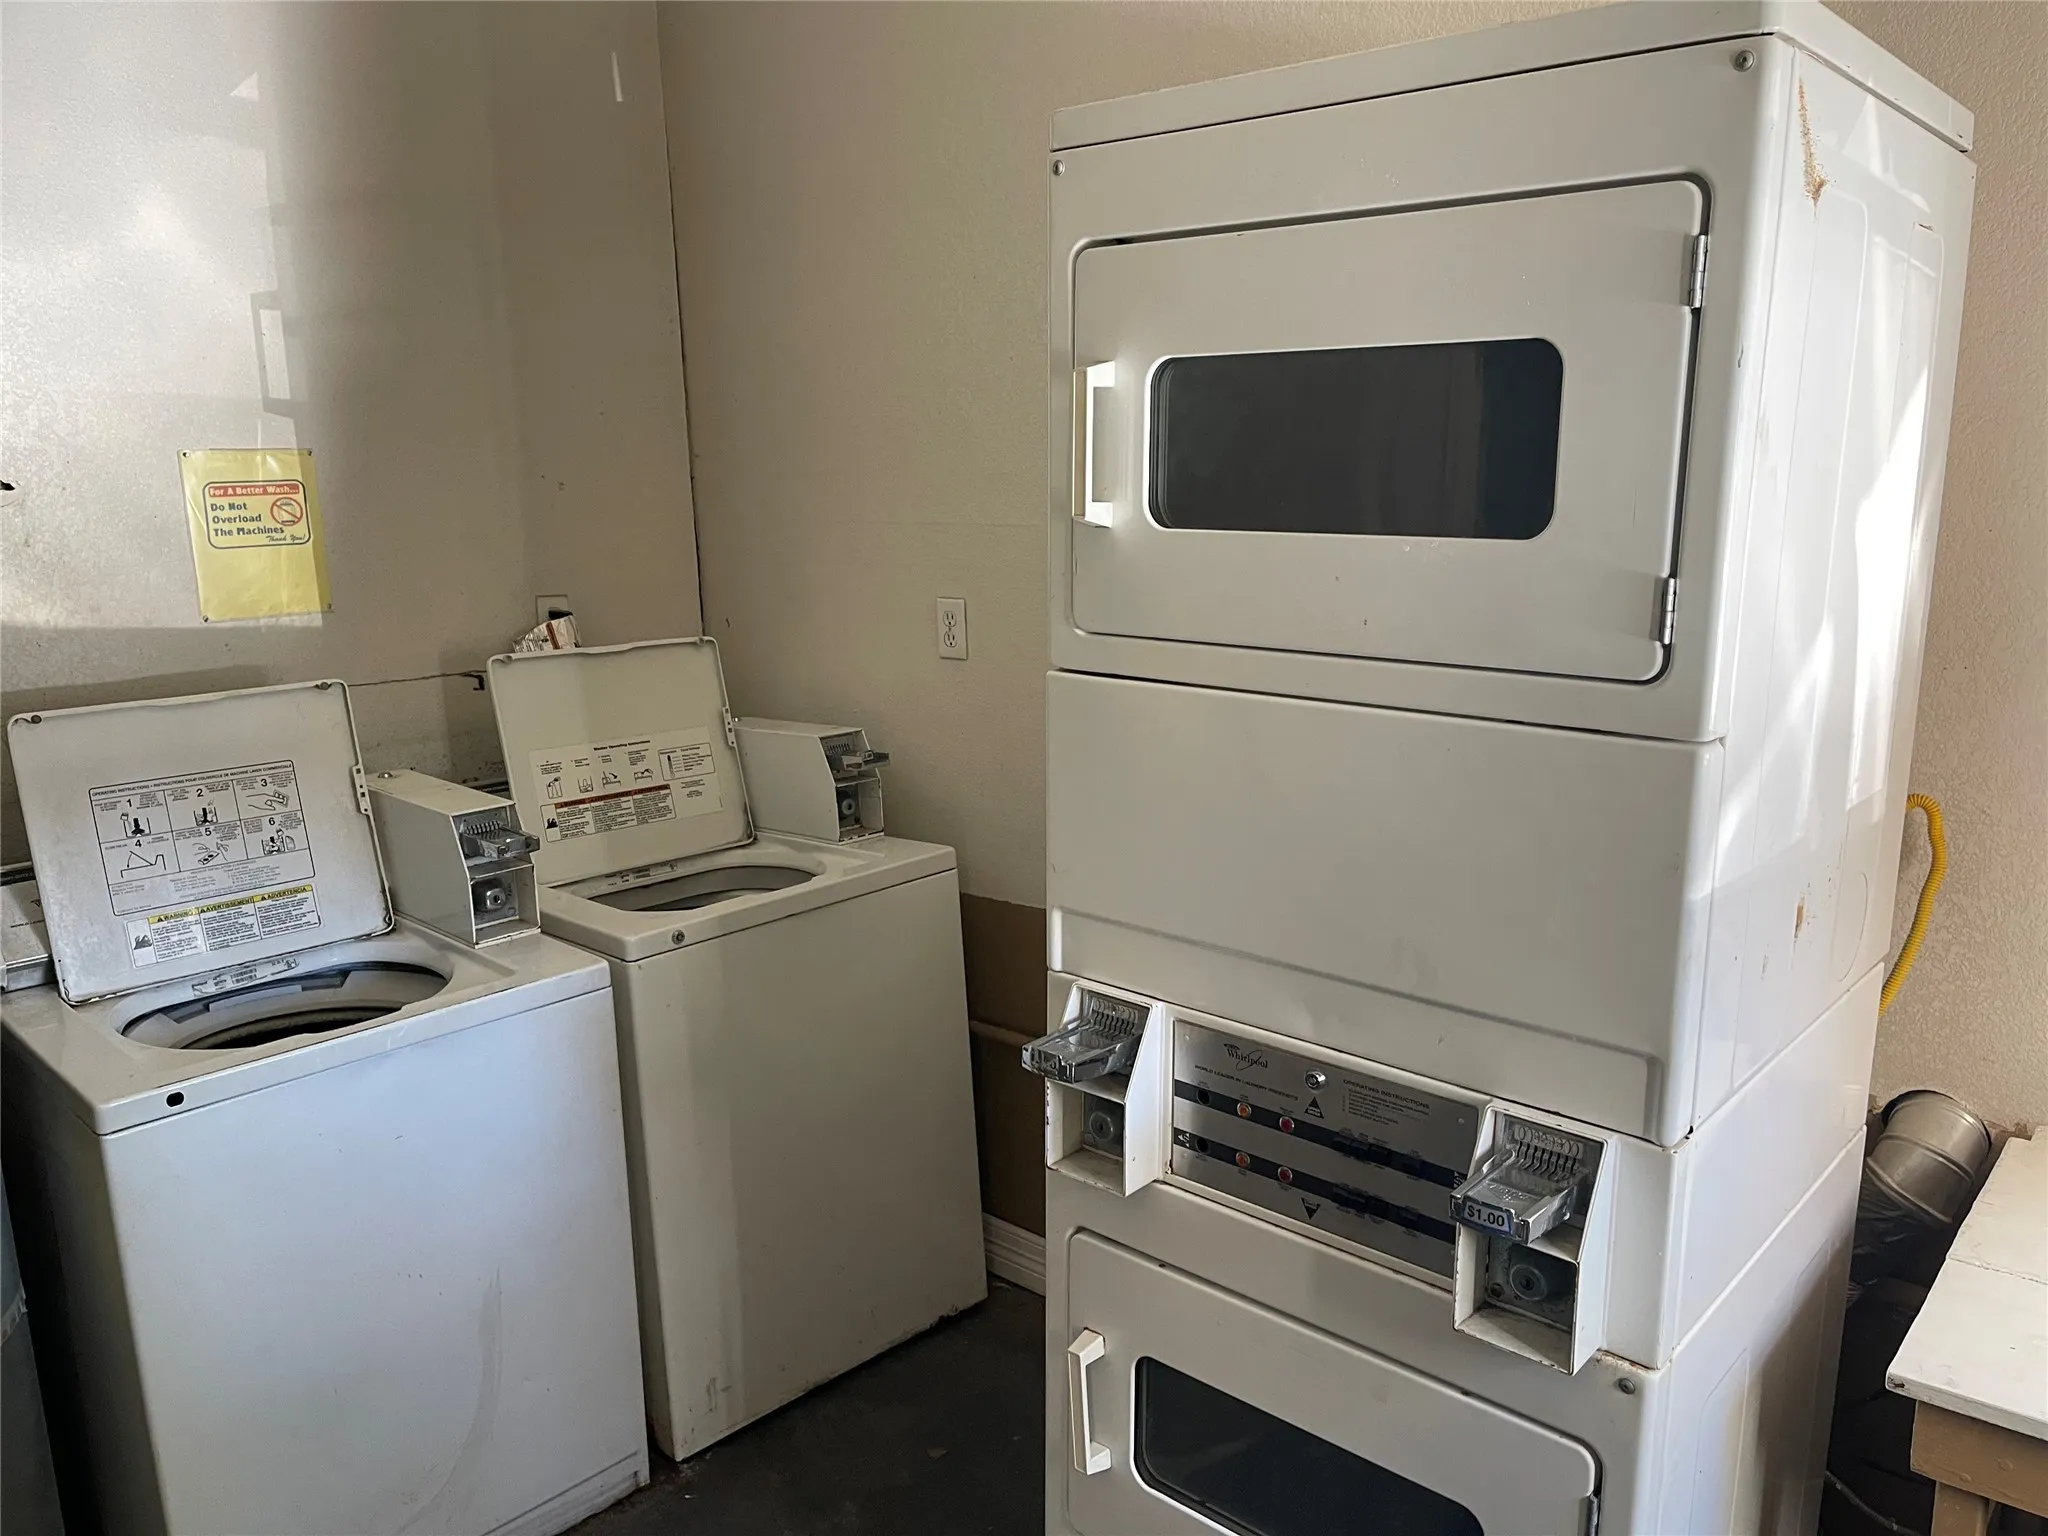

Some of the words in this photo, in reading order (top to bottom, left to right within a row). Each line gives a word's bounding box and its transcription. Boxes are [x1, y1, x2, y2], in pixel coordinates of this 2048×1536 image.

[209, 487, 224, 496] For
[227, 487, 234, 495] A
[235, 486, 264, 495] Better
[265, 485, 299, 494] Wash...
[210, 503, 225, 512] Do
[228, 502, 248, 511] Not
[212, 514, 262, 524] Overload
[213, 528, 234, 537] The
[236, 526, 285, 536] Machines
[265, 534, 287, 542] Thank
[260, 778, 268, 787] 3
[196, 788, 204, 797] 2
[126, 798, 132, 808] 1
[268, 817, 276, 826] 6
[204, 827, 212, 837] 5
[135, 839, 142, 848] 4
[266, 887, 308, 900] ADVERTENCIA
[1227, 1048, 1268, 1069] Whirlpool
[1381, 1090, 1430, 1109] INSTRUCTIONS
[1467, 1204, 1506, 1228] $1.00
